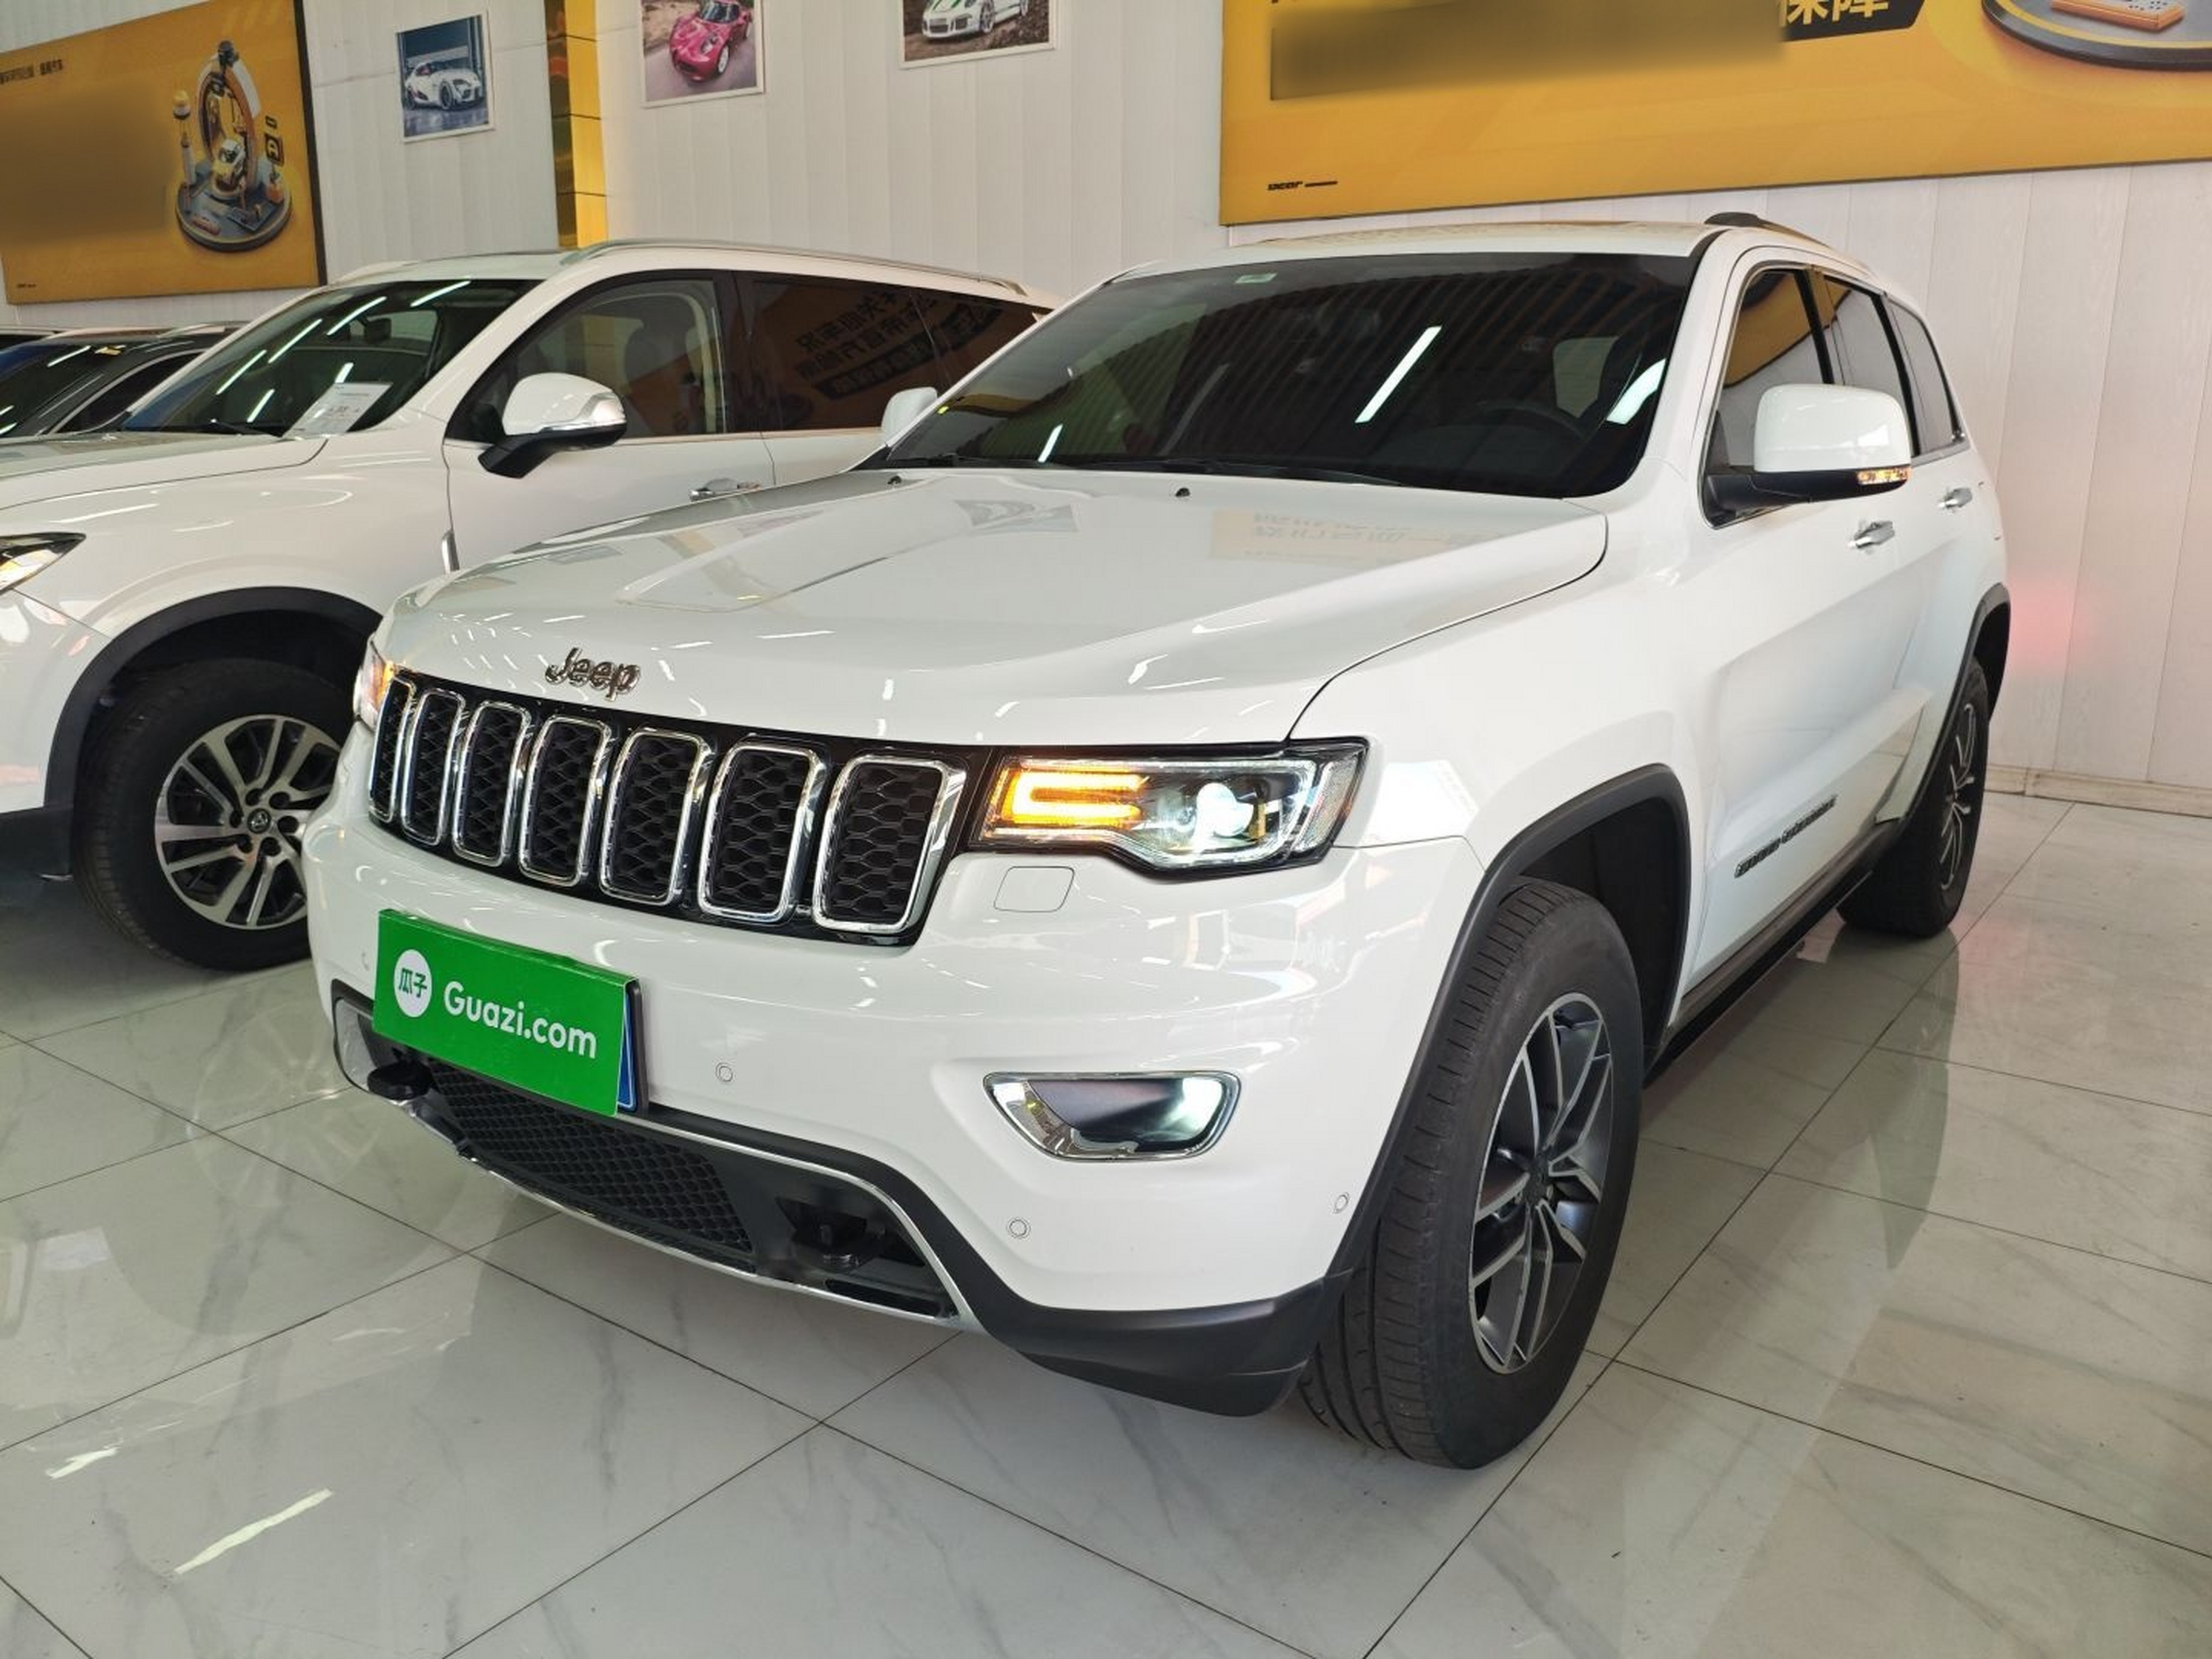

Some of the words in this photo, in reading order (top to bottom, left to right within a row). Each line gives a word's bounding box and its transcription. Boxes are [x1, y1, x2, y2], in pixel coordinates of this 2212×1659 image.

[545, 647, 640, 702] Jeep
[399, 968, 427, 998] 瓜子
[444, 980, 597, 1059] Guazi.com
